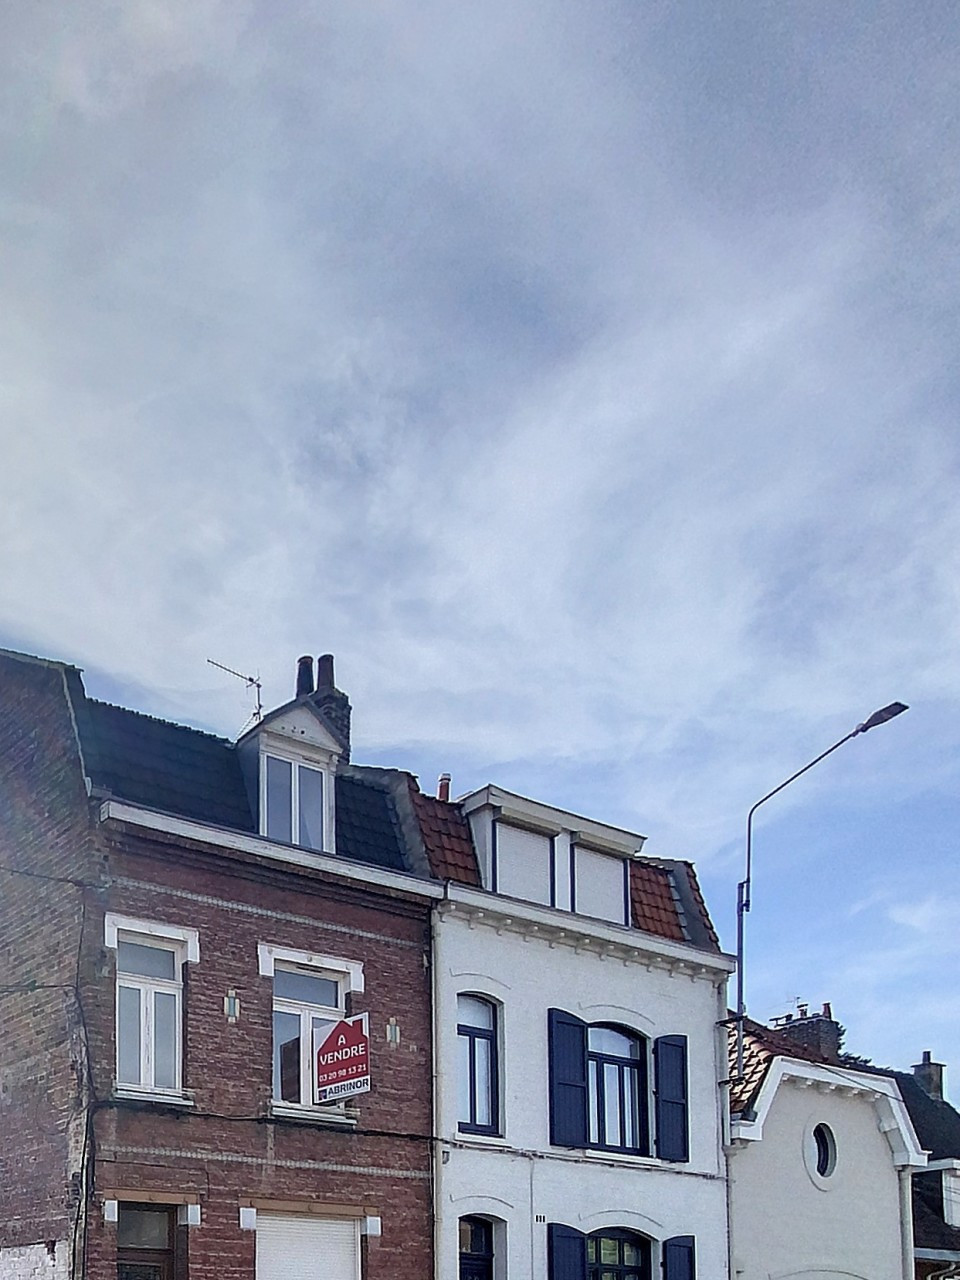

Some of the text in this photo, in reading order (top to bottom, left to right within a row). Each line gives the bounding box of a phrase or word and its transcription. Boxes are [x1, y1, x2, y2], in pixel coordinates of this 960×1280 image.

[338, 1035, 346, 1046] A
[320, 1043, 366, 1066] VENDRE
[319, 1074, 327, 1082] 03
[328, 1078, 369, 1096] ABRINOR
